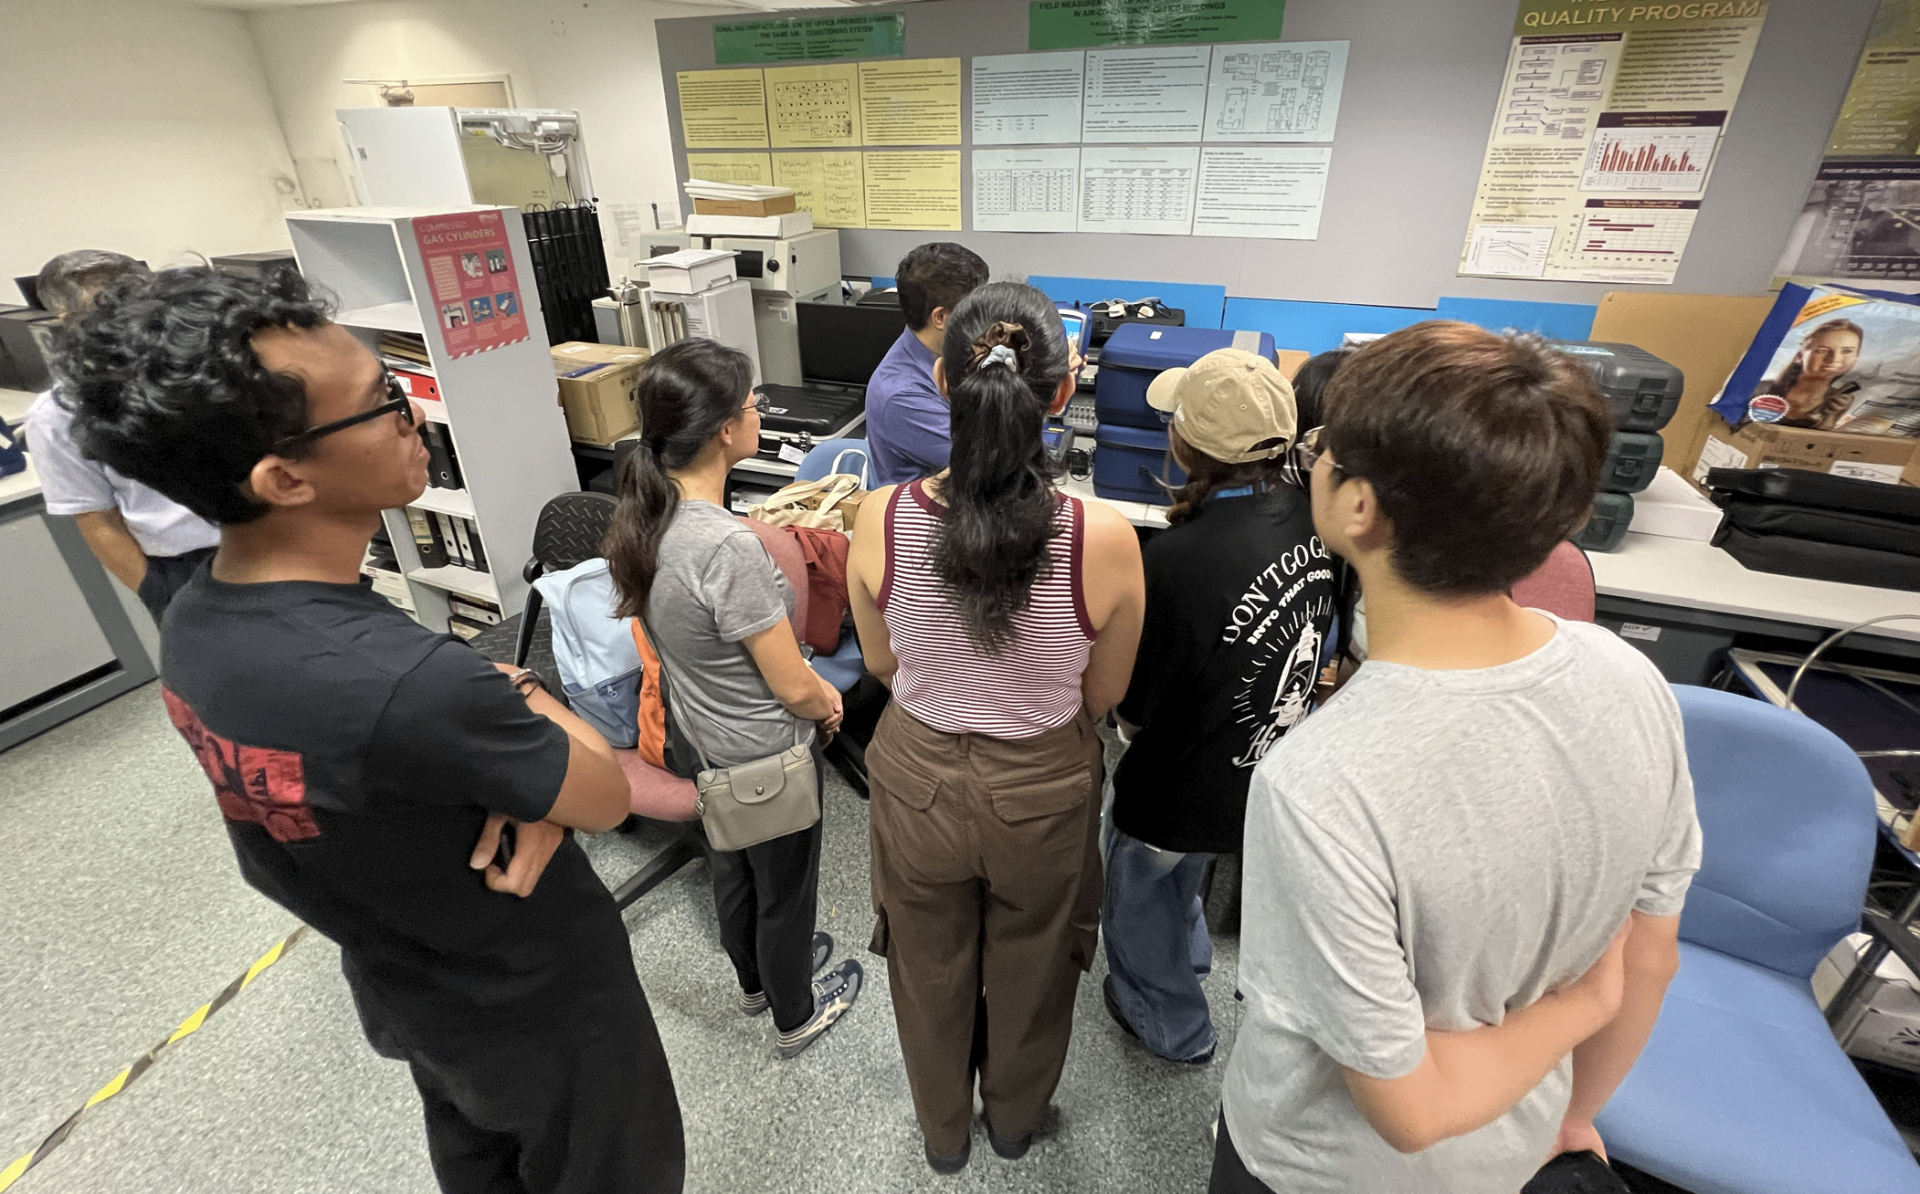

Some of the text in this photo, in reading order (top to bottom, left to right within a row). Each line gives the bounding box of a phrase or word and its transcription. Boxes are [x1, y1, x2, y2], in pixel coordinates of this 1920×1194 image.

[1039, 1, 1059, 10] FIELD
[837, 17, 867, 25] PREMISES
[868, 15, 898, 23] SHARING
[1523, 2, 1759, 27] QUALITY PROGRAM
[806, 27, 848, 36] CONDITIONING
[849, 25, 873, 33] SYSTEM
[420, 221, 467, 232] COMPRESSED
[423, 228, 496, 245] GAS CYLINDERS
[1222, 562, 1284, 645] DON'T
[1281, 544, 1309, 575] GO
[1247, 569, 1331, 645] INTO THAT GOOD
